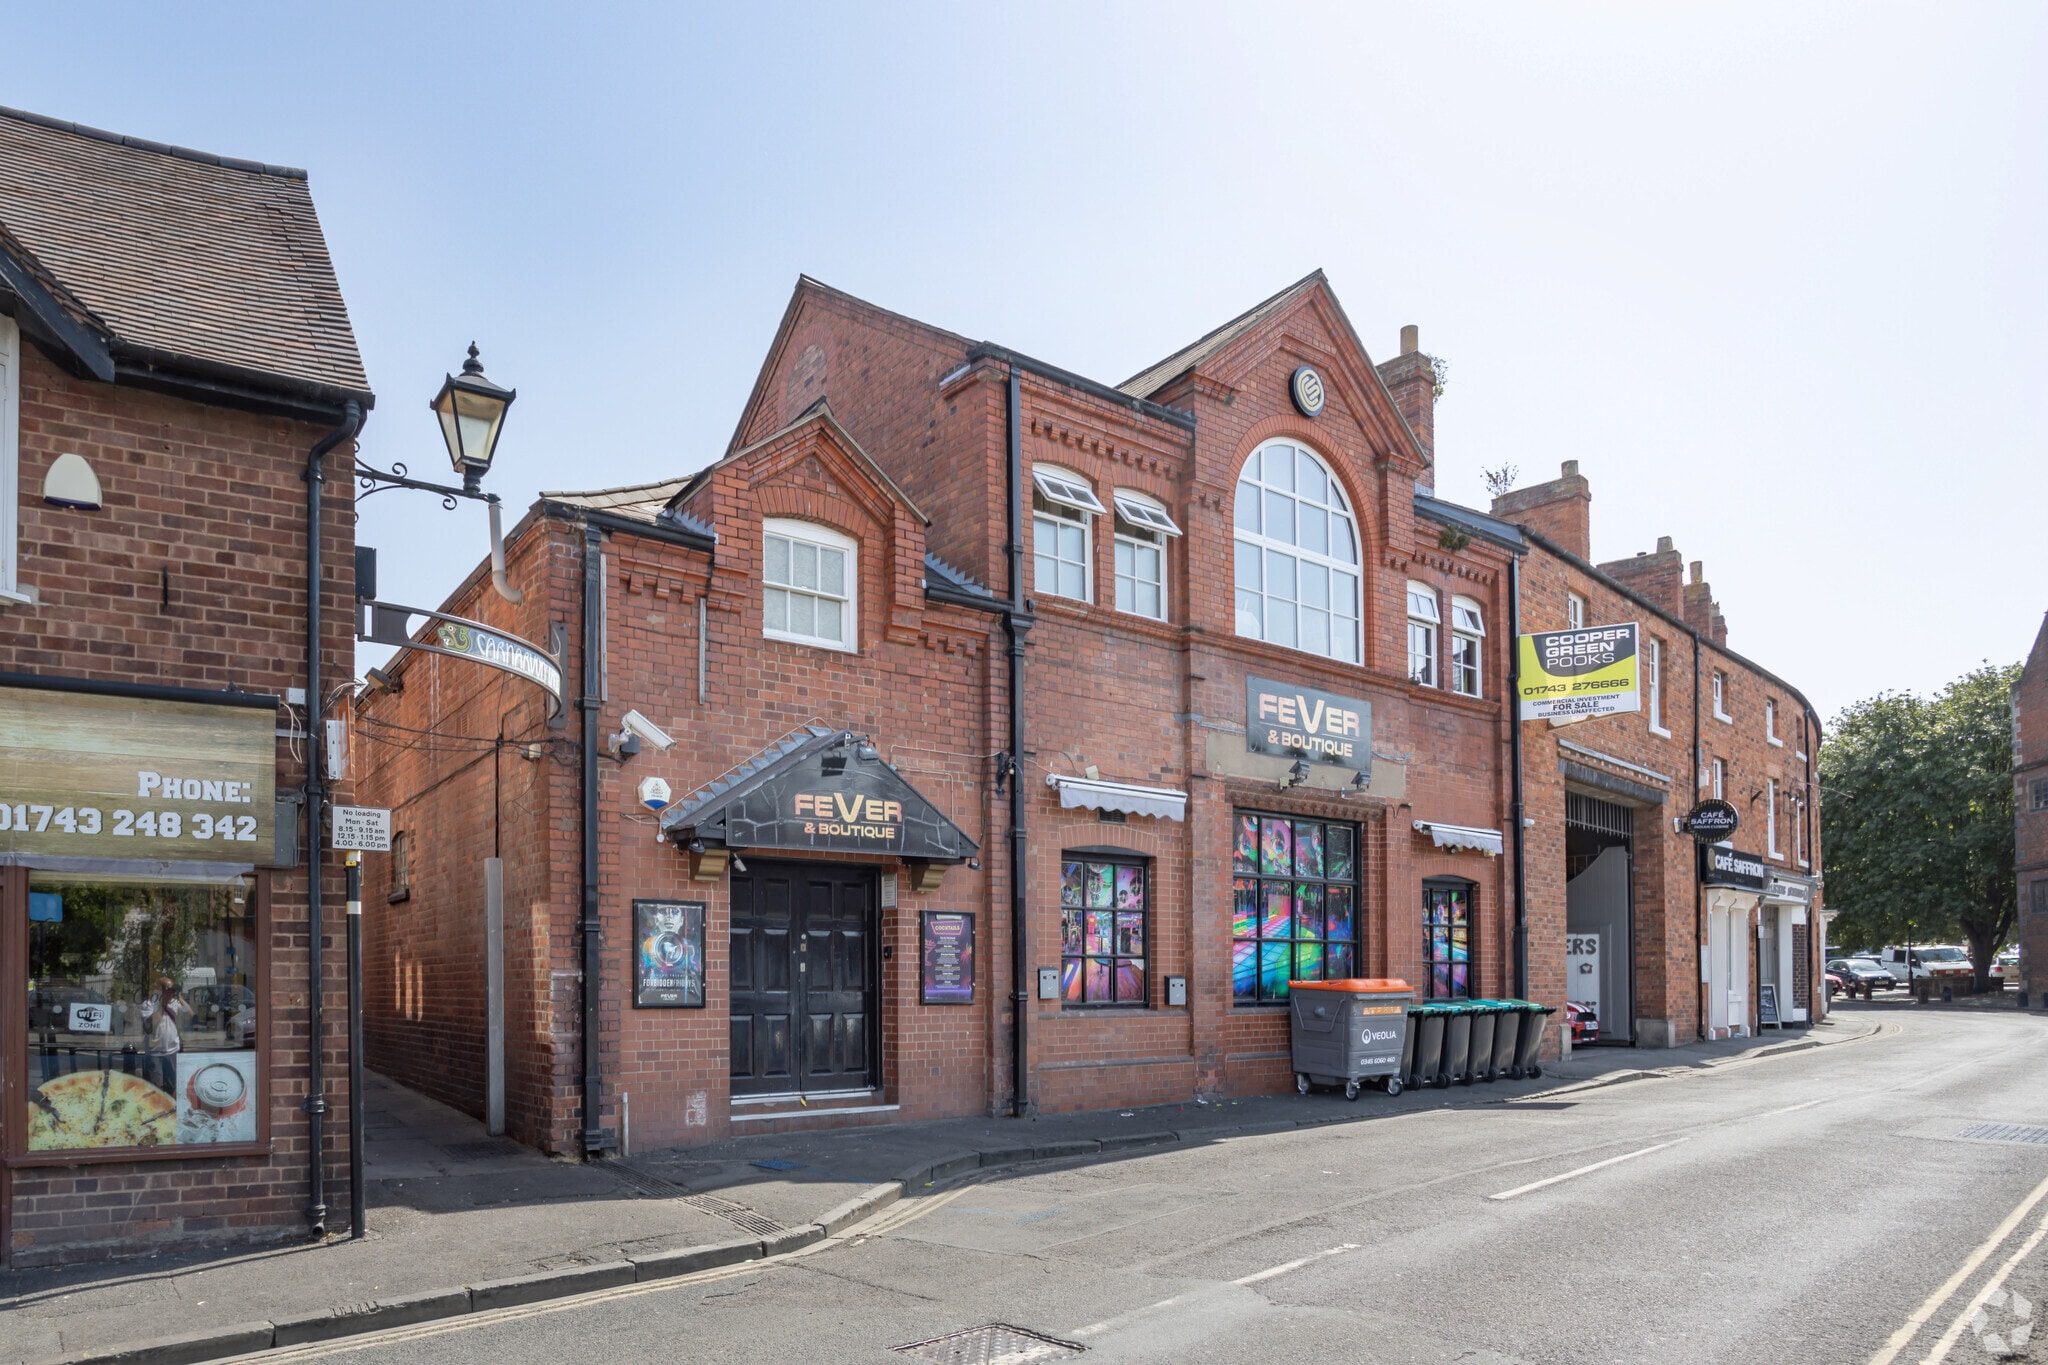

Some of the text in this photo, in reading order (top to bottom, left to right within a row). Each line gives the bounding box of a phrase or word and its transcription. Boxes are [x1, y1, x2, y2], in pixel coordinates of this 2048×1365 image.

[1545, 628, 1630, 646] COOPER
[1545, 642, 1614, 658] GREEN
[1546, 653, 1614, 669] POOKS
[1524, 678, 1630, 695] 01743 276666
[1532, 694, 1620, 706] COMMERCIAL INVESTMENT
[1552, 703, 1572, 711] FOR
[1259, 693, 1360, 737] FEVER
[1538, 706, 1615, 718] BUSINESS UNAFFECTED
[1268, 730, 1352, 758] & BOUTIQUE
[355, 810, 381, 818] loading
[794, 793, 902, 823] FEVER
[1700, 810, 1724, 818] CAFÉ
[112, 809, 182, 838] 248
[192, 813, 258, 842] 342
[1690, 814, 1734, 824] SAFFRON
[804, 822, 895, 838] & BOUTIQUE
[1715, 852, 1764, 878] CAFÉ SAFFRON
[1372, 1031, 1396, 1040] VEOLIA
